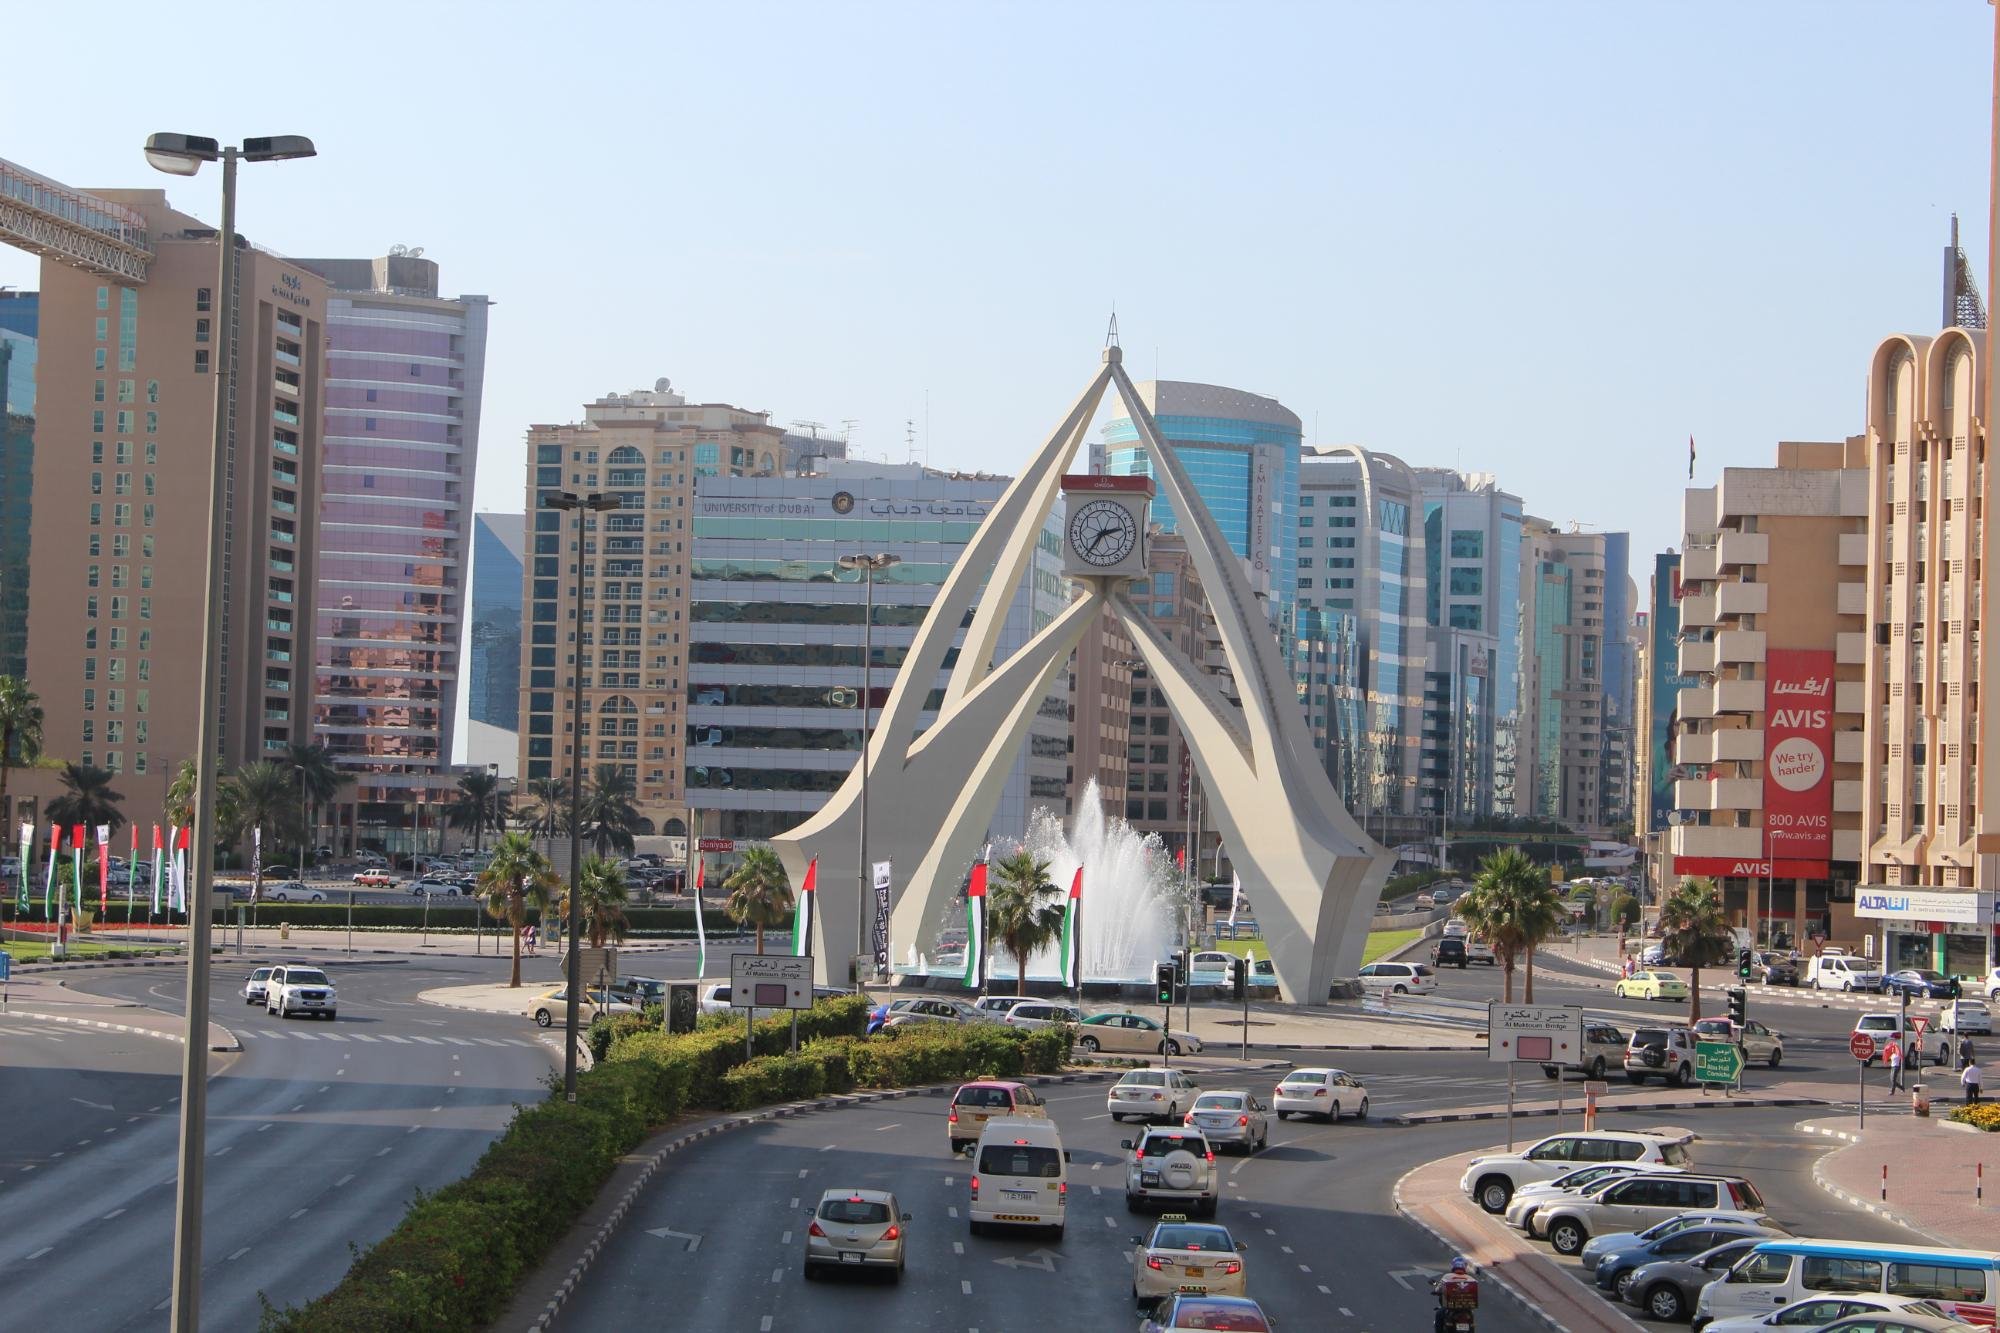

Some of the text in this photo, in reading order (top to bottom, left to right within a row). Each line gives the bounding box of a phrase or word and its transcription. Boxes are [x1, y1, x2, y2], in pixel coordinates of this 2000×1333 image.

[704, 503, 815, 514] UNIVERSITY of DUBAI
[1256, 463, 1266, 544] EMIRATES
[871, 504, 920, 517] دبي
[1664, 675, 1695, 685] YOUR
[1771, 709, 1826, 728] AVIS
[1775, 752, 1814, 764] We try
[1778, 763, 1816, 776] harder
[1769, 814, 1827, 827] 800 AVIS
[700, 841, 733, 850] Buniyaad
[1732, 862, 1770, 875] AVIS
[743, 960, 802, 971] جسر آل مكتوم
[1504, 1009, 1569, 1022] جسر آل مكتوم
[1853, 1047, 1871, 1055] STOP
